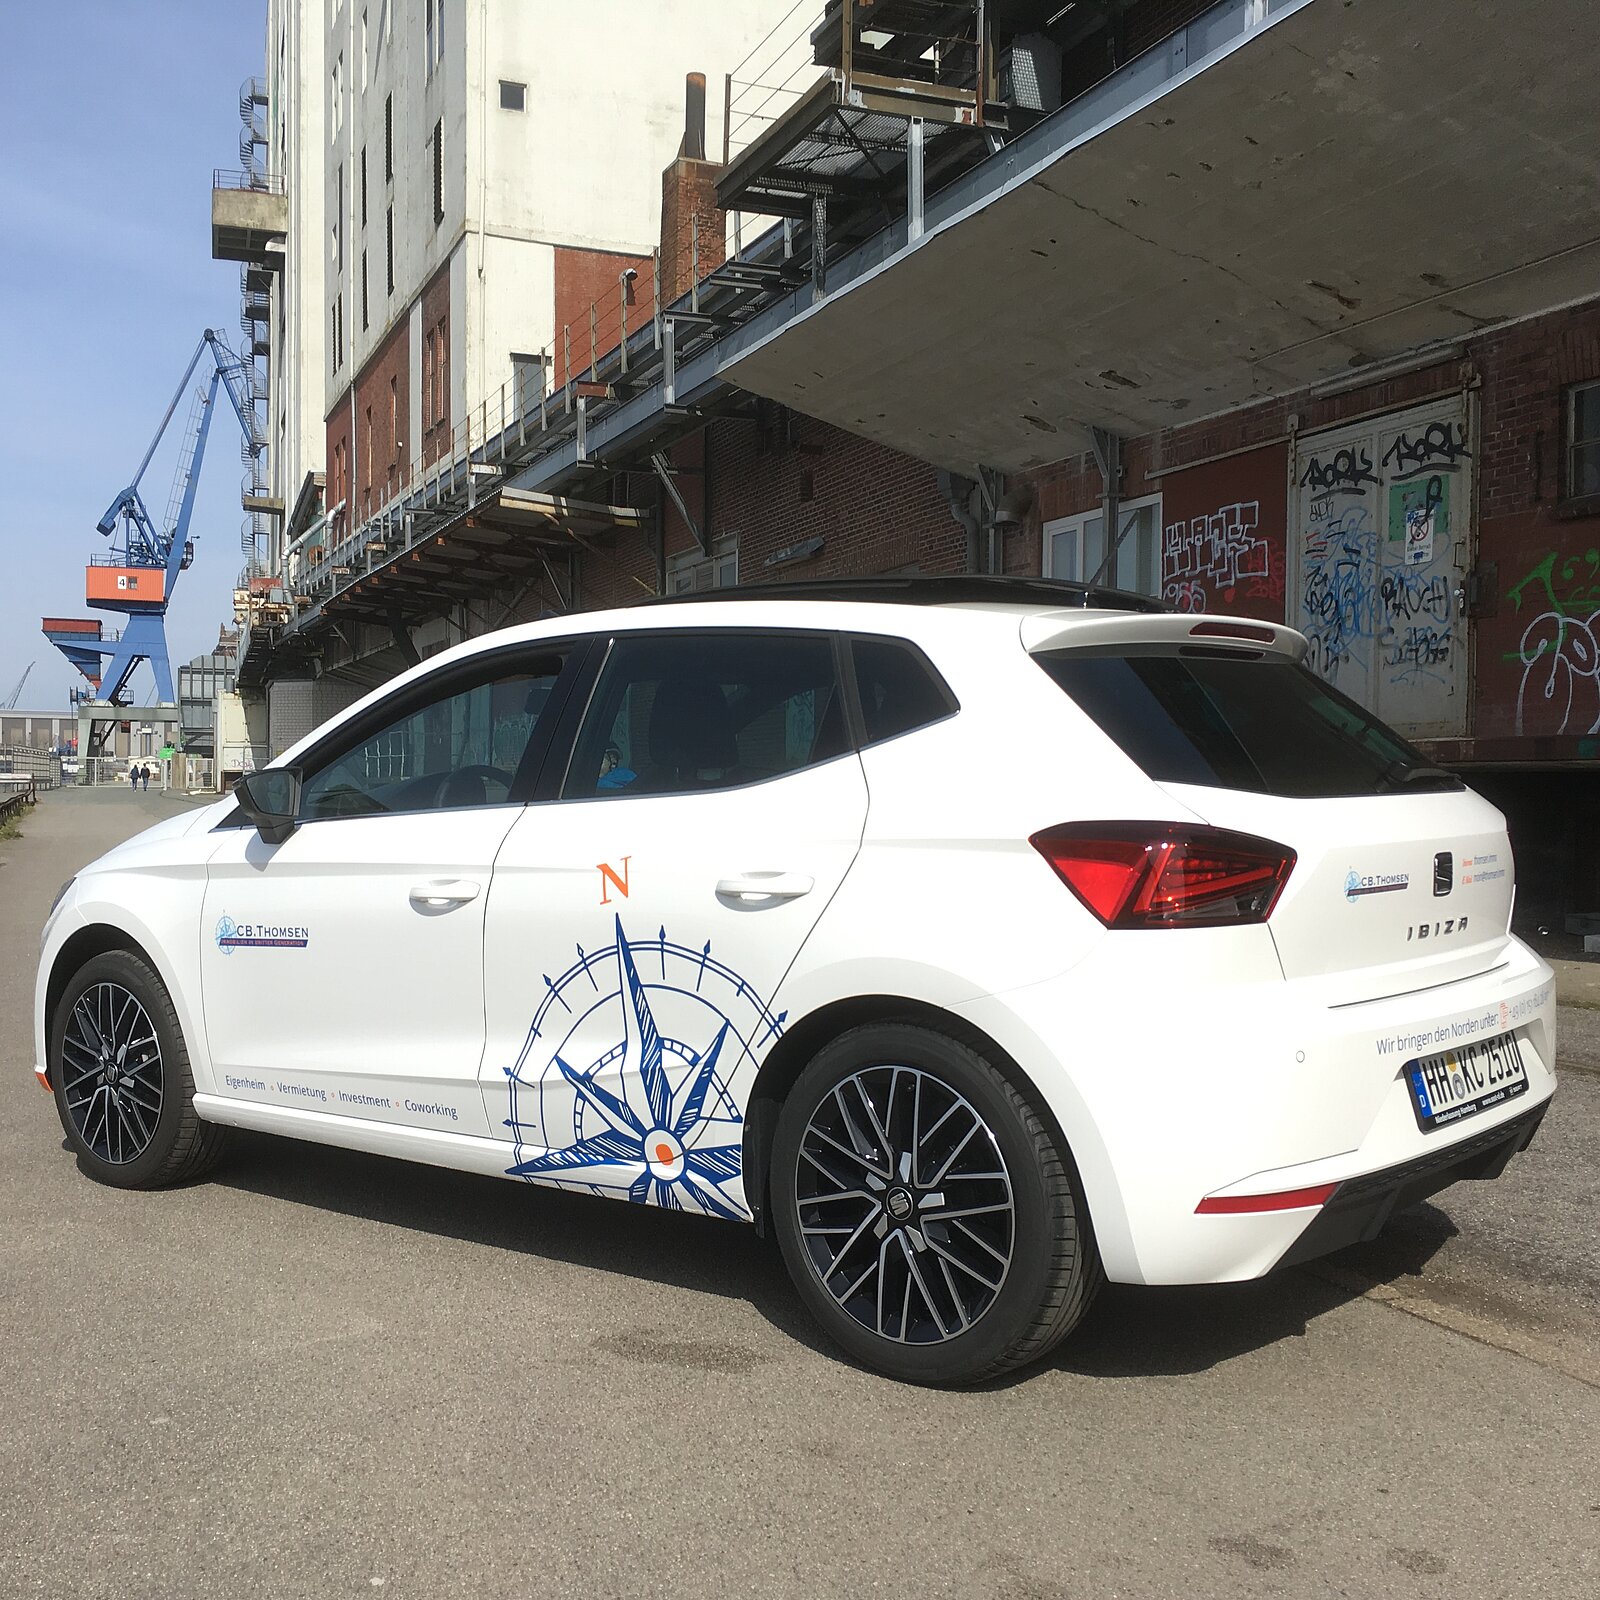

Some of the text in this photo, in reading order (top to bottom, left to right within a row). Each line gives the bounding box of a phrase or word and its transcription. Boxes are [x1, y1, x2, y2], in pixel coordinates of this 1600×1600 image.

[119, 578, 126, 587] 4
[596, 856, 632, 905] N
[1407, 917, 1468, 941] IBIZA
[1376, 1038, 1395, 1055] Wir
[1397, 1032, 1433, 1052] bringen
[1434, 1026, 1450, 1043] den
[1451, 1018, 1480, 1038] Norden
[1422, 1032, 1520, 1107] HH KC 2510
[225, 1075, 459, 1121] Eigenheim Vermietung Investment Coworking
[1419, 1094, 1427, 1108] D
